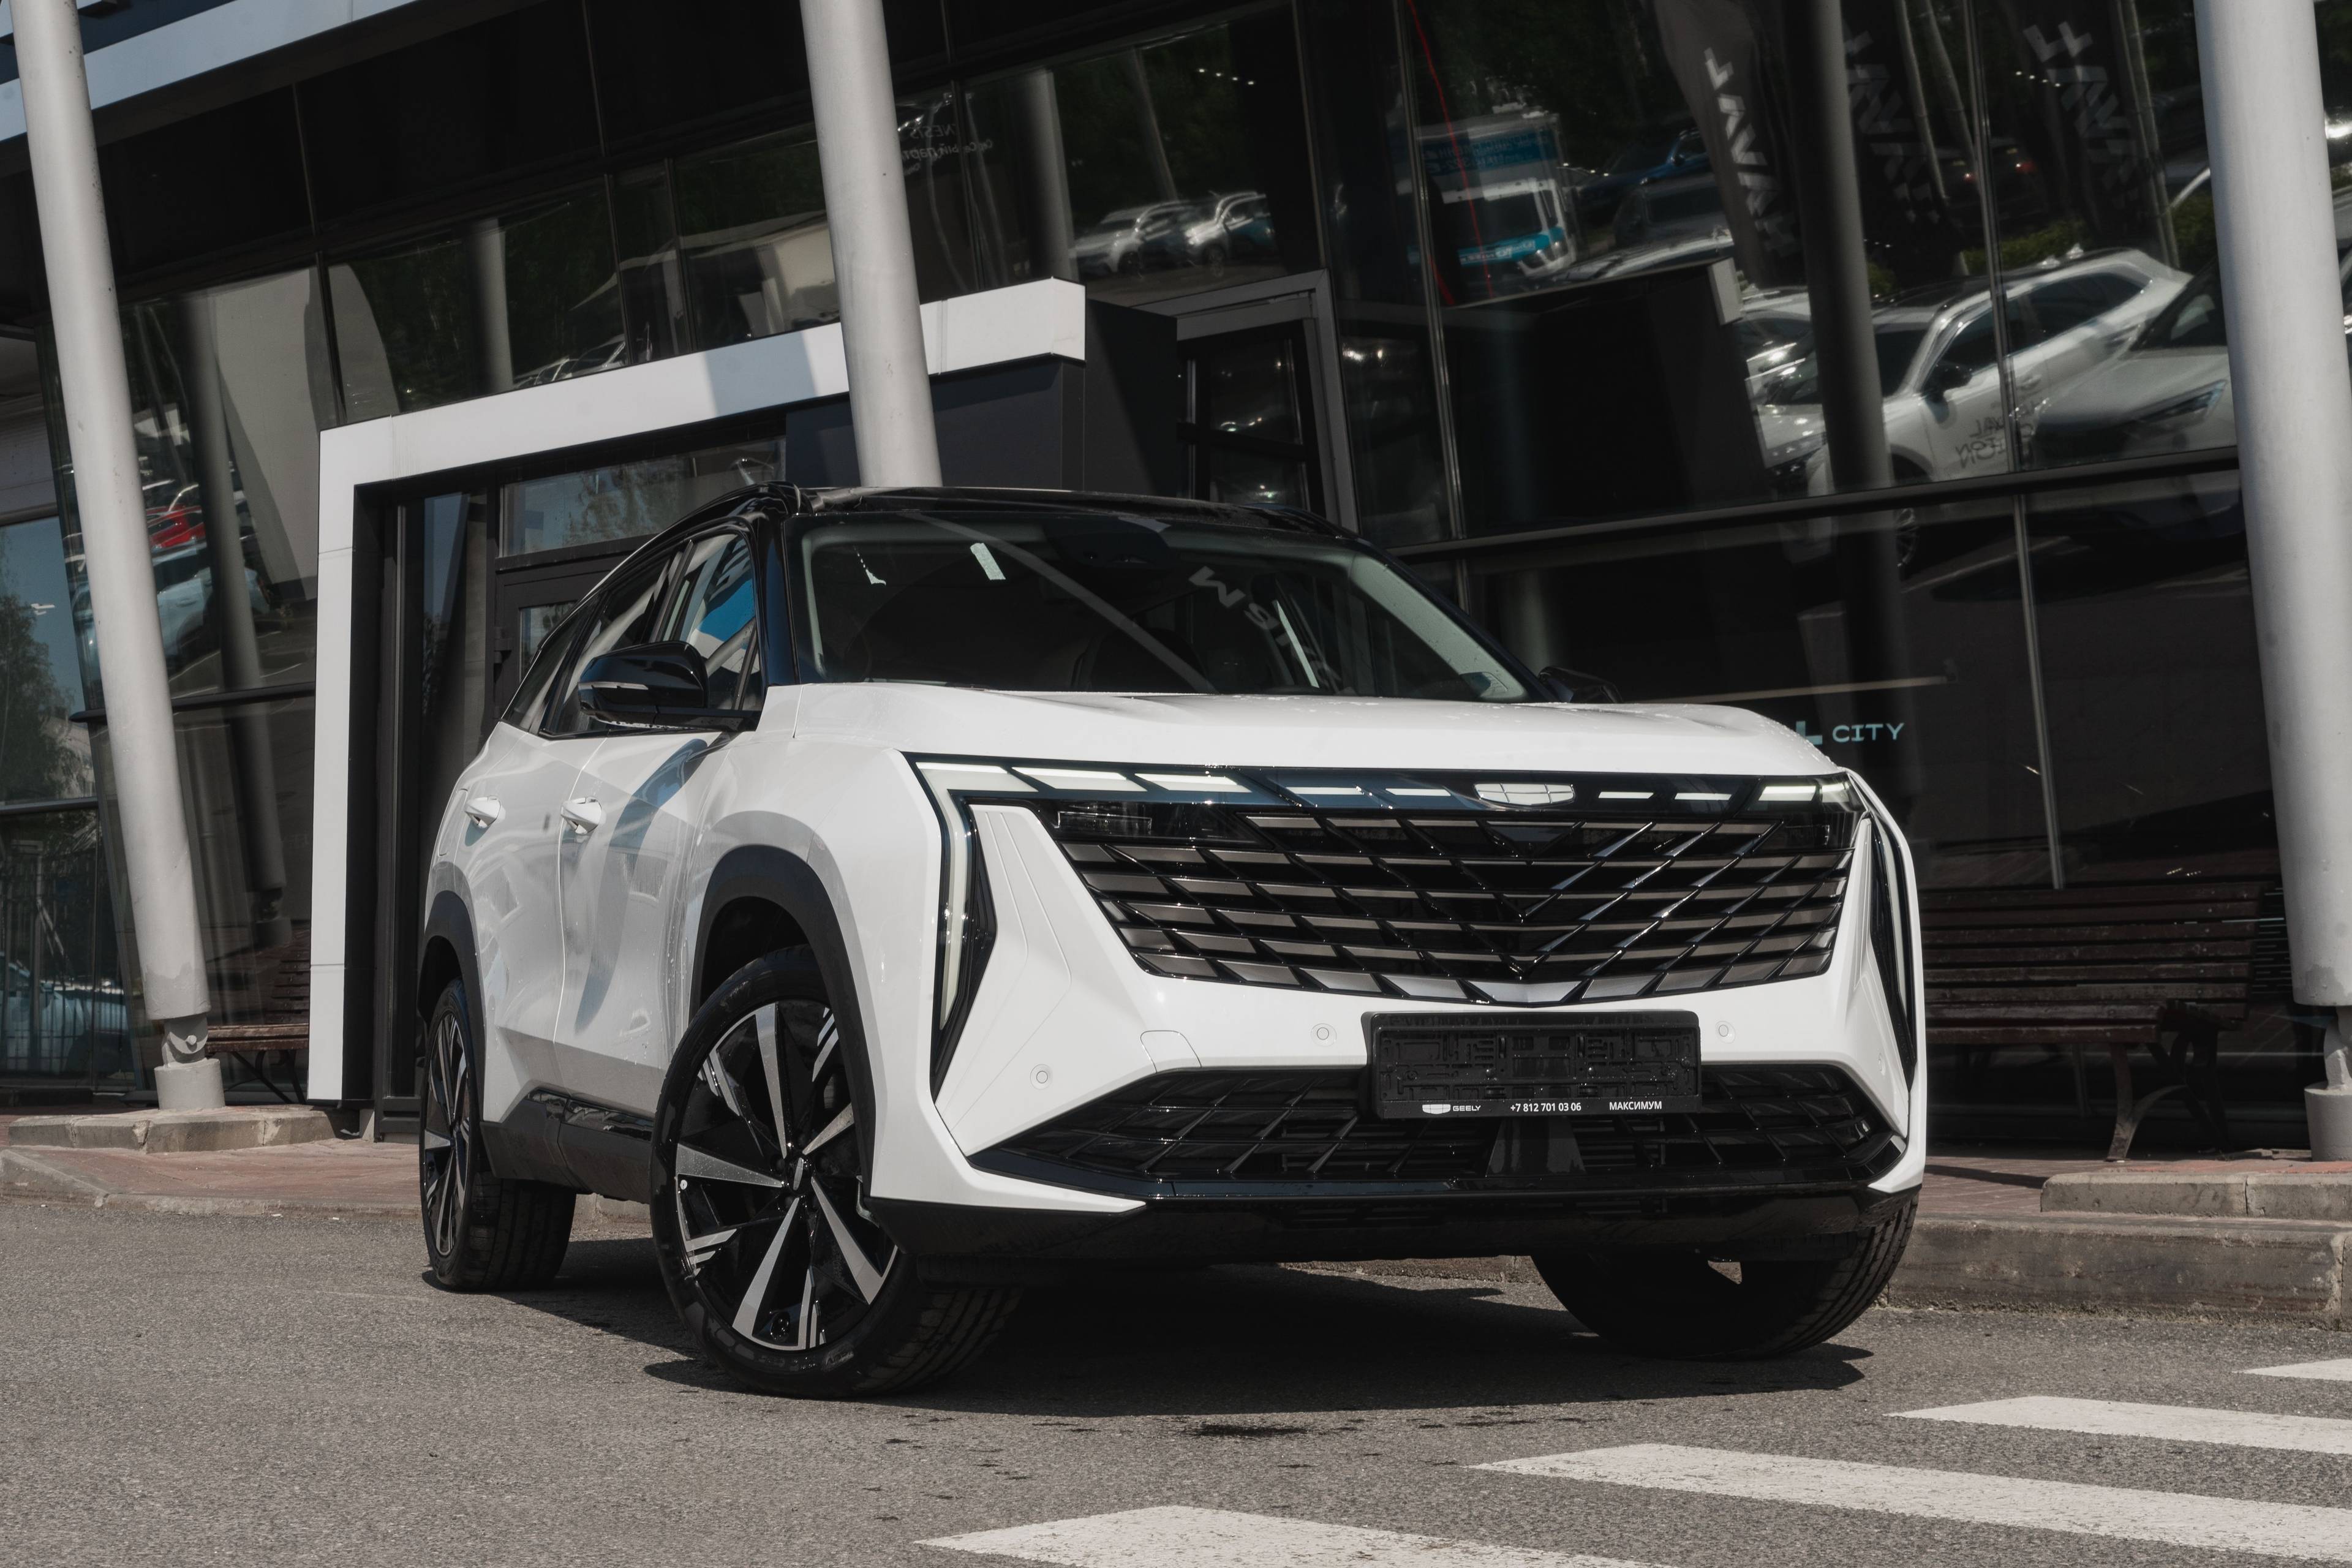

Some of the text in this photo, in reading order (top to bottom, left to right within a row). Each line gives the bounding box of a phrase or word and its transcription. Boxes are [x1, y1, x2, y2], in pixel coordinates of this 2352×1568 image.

[1832, 722, 1905, 743] CITY
[1510, 1102, 1582, 1112] +7 812 701 03 06
[1609, 1101, 1663, 1110] МАКСИМУМ
